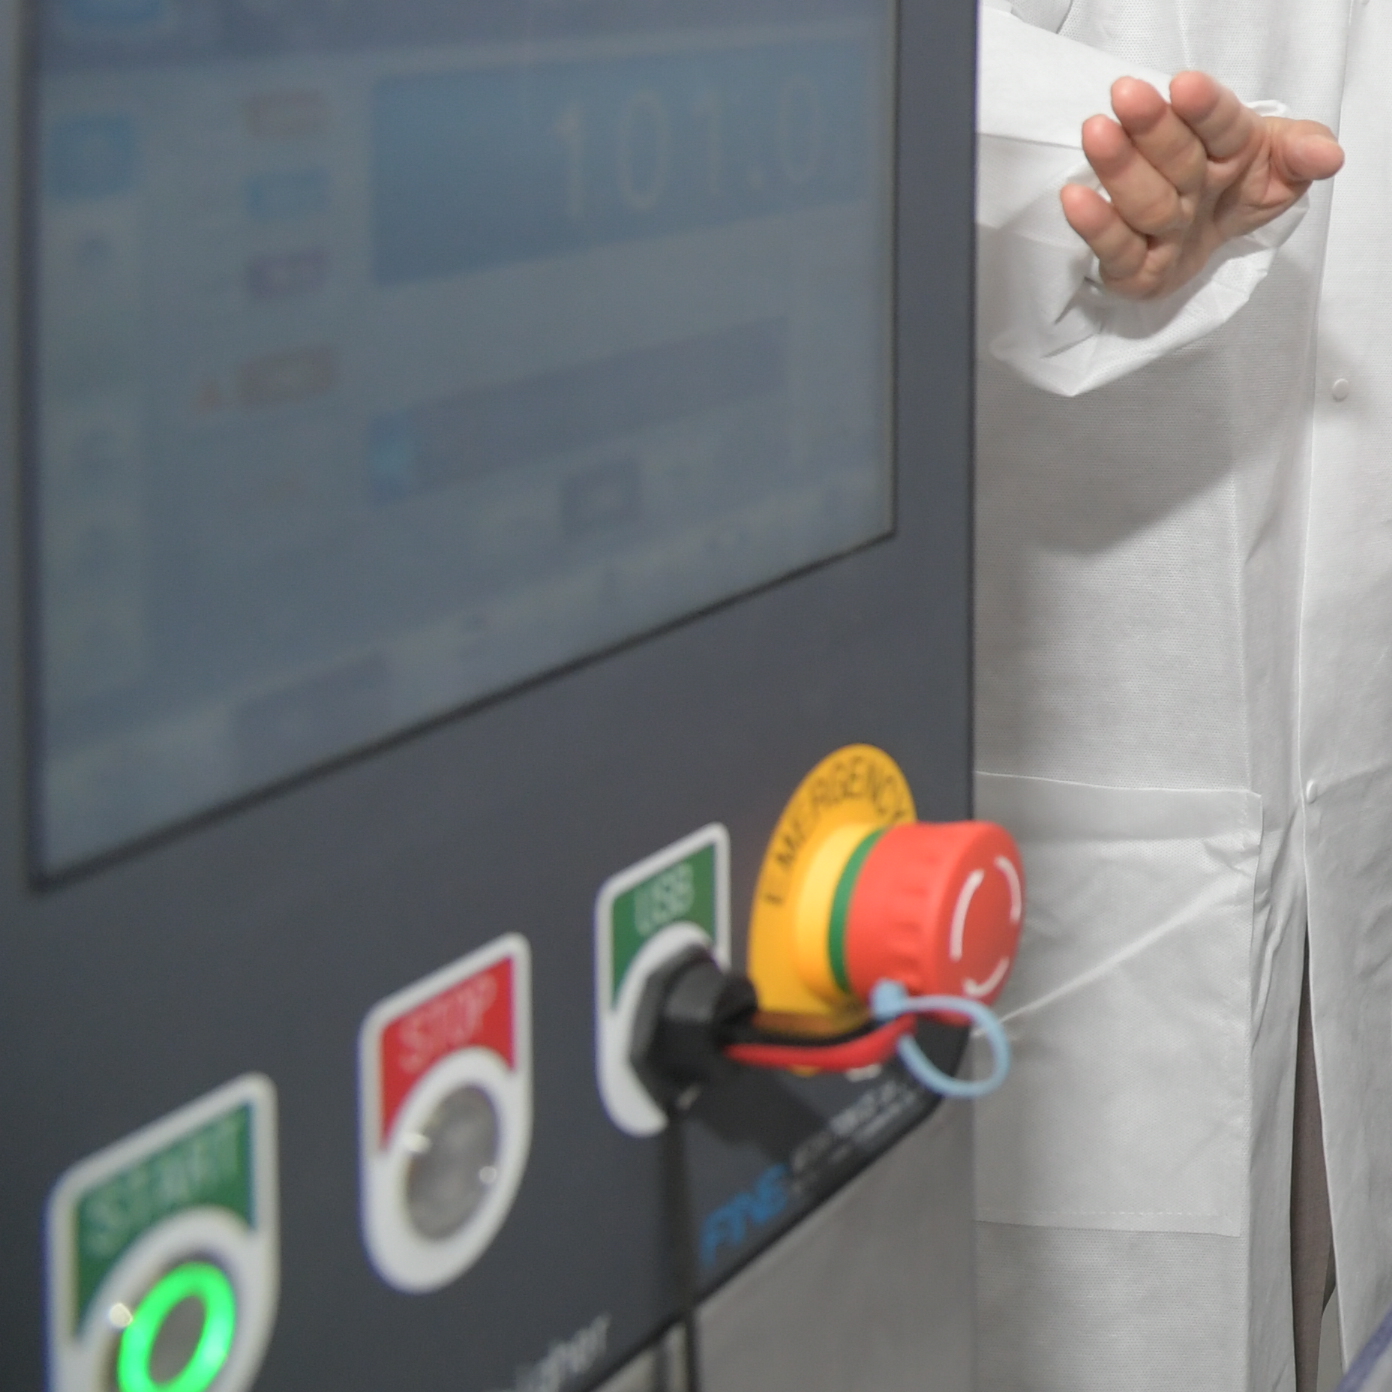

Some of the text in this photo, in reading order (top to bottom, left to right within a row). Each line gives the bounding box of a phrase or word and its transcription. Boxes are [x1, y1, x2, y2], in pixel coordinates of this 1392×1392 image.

[551, 73, 821, 217] 101.0
[634, 862, 695, 937] USB
[398, 971, 497, 1074] STOP
[84, 1116, 240, 1257] START
